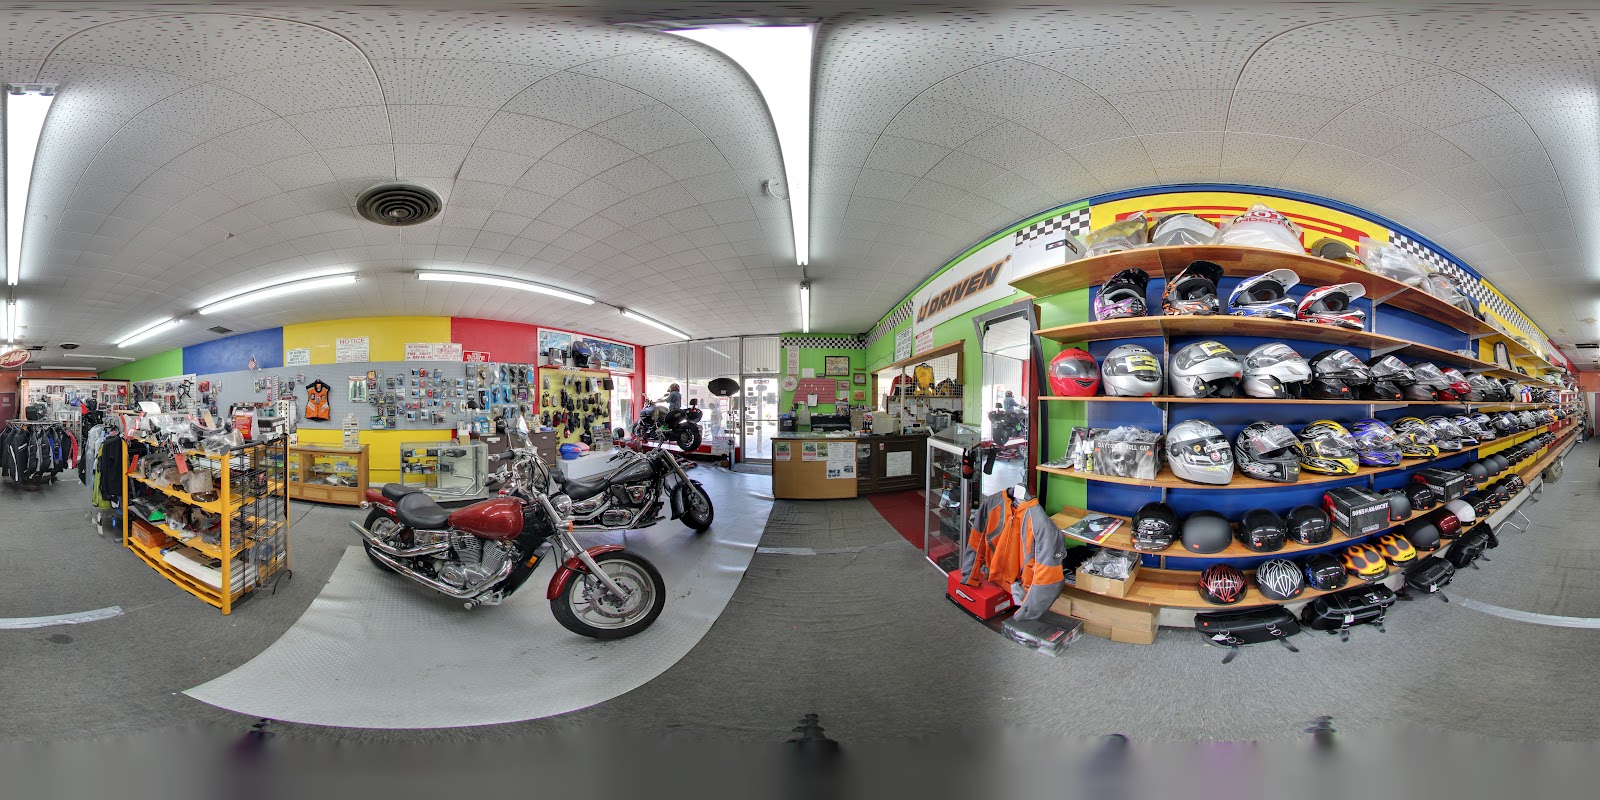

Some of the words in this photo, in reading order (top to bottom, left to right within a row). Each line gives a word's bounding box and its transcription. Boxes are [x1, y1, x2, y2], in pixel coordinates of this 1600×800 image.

[926, 260, 1005, 318] DRIVEN
[0, 351, 28, 364] FMF
[1351, 508, 1365, 517] SONS
